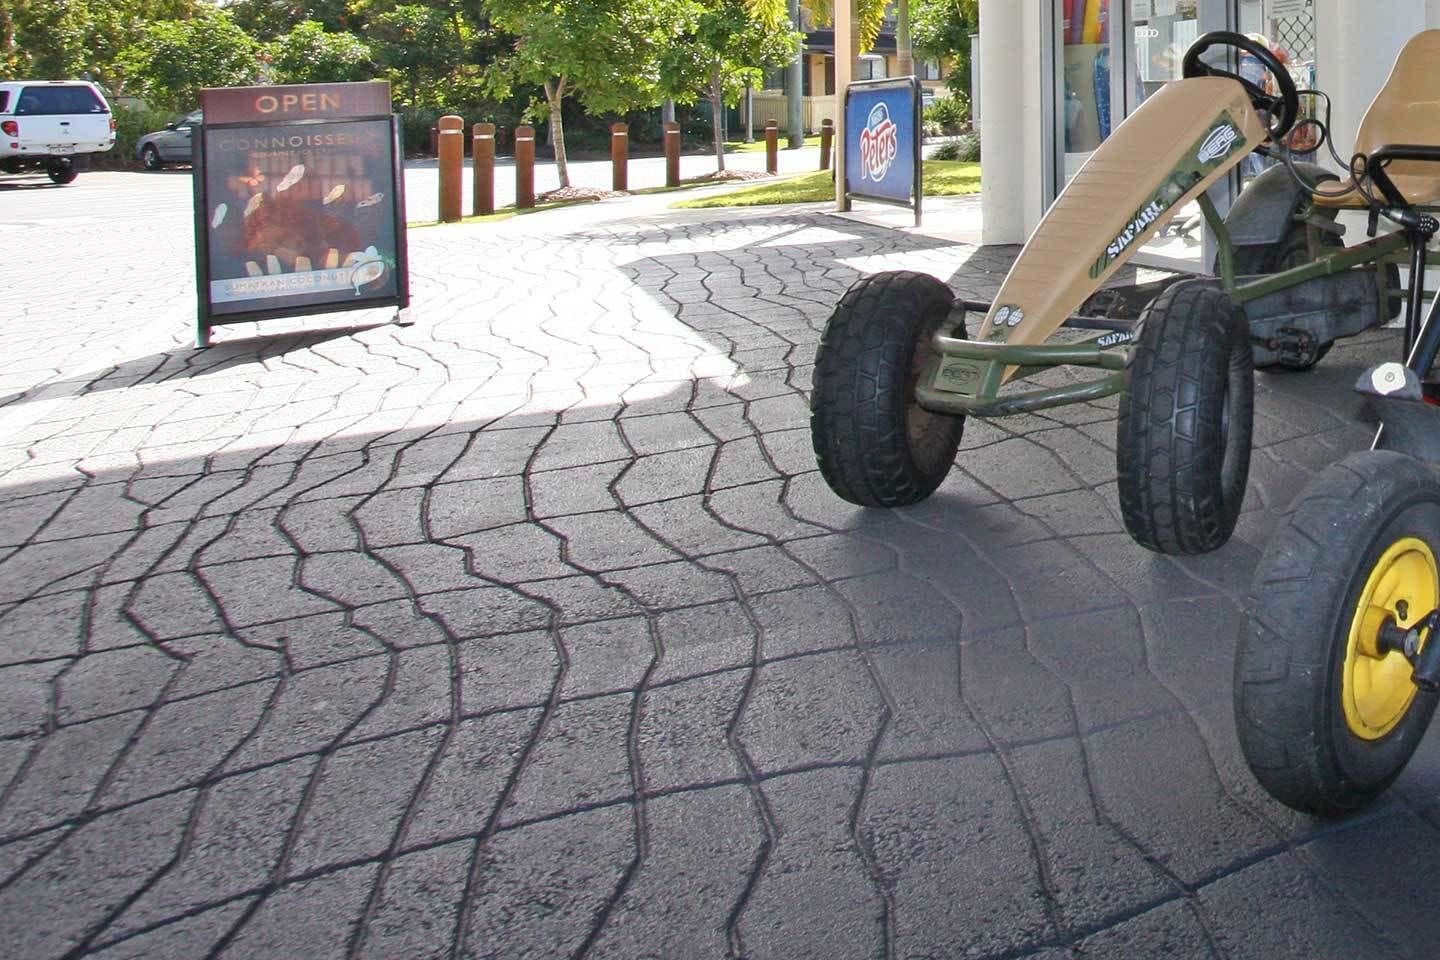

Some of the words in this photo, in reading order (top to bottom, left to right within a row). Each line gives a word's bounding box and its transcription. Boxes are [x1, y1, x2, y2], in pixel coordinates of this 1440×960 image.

[255, 93, 343, 114] OPEN
[1197, 124, 1238, 164] BERG
[1106, 200, 1164, 259] SAFARI
[1097, 330, 1137, 346] SAFAR
